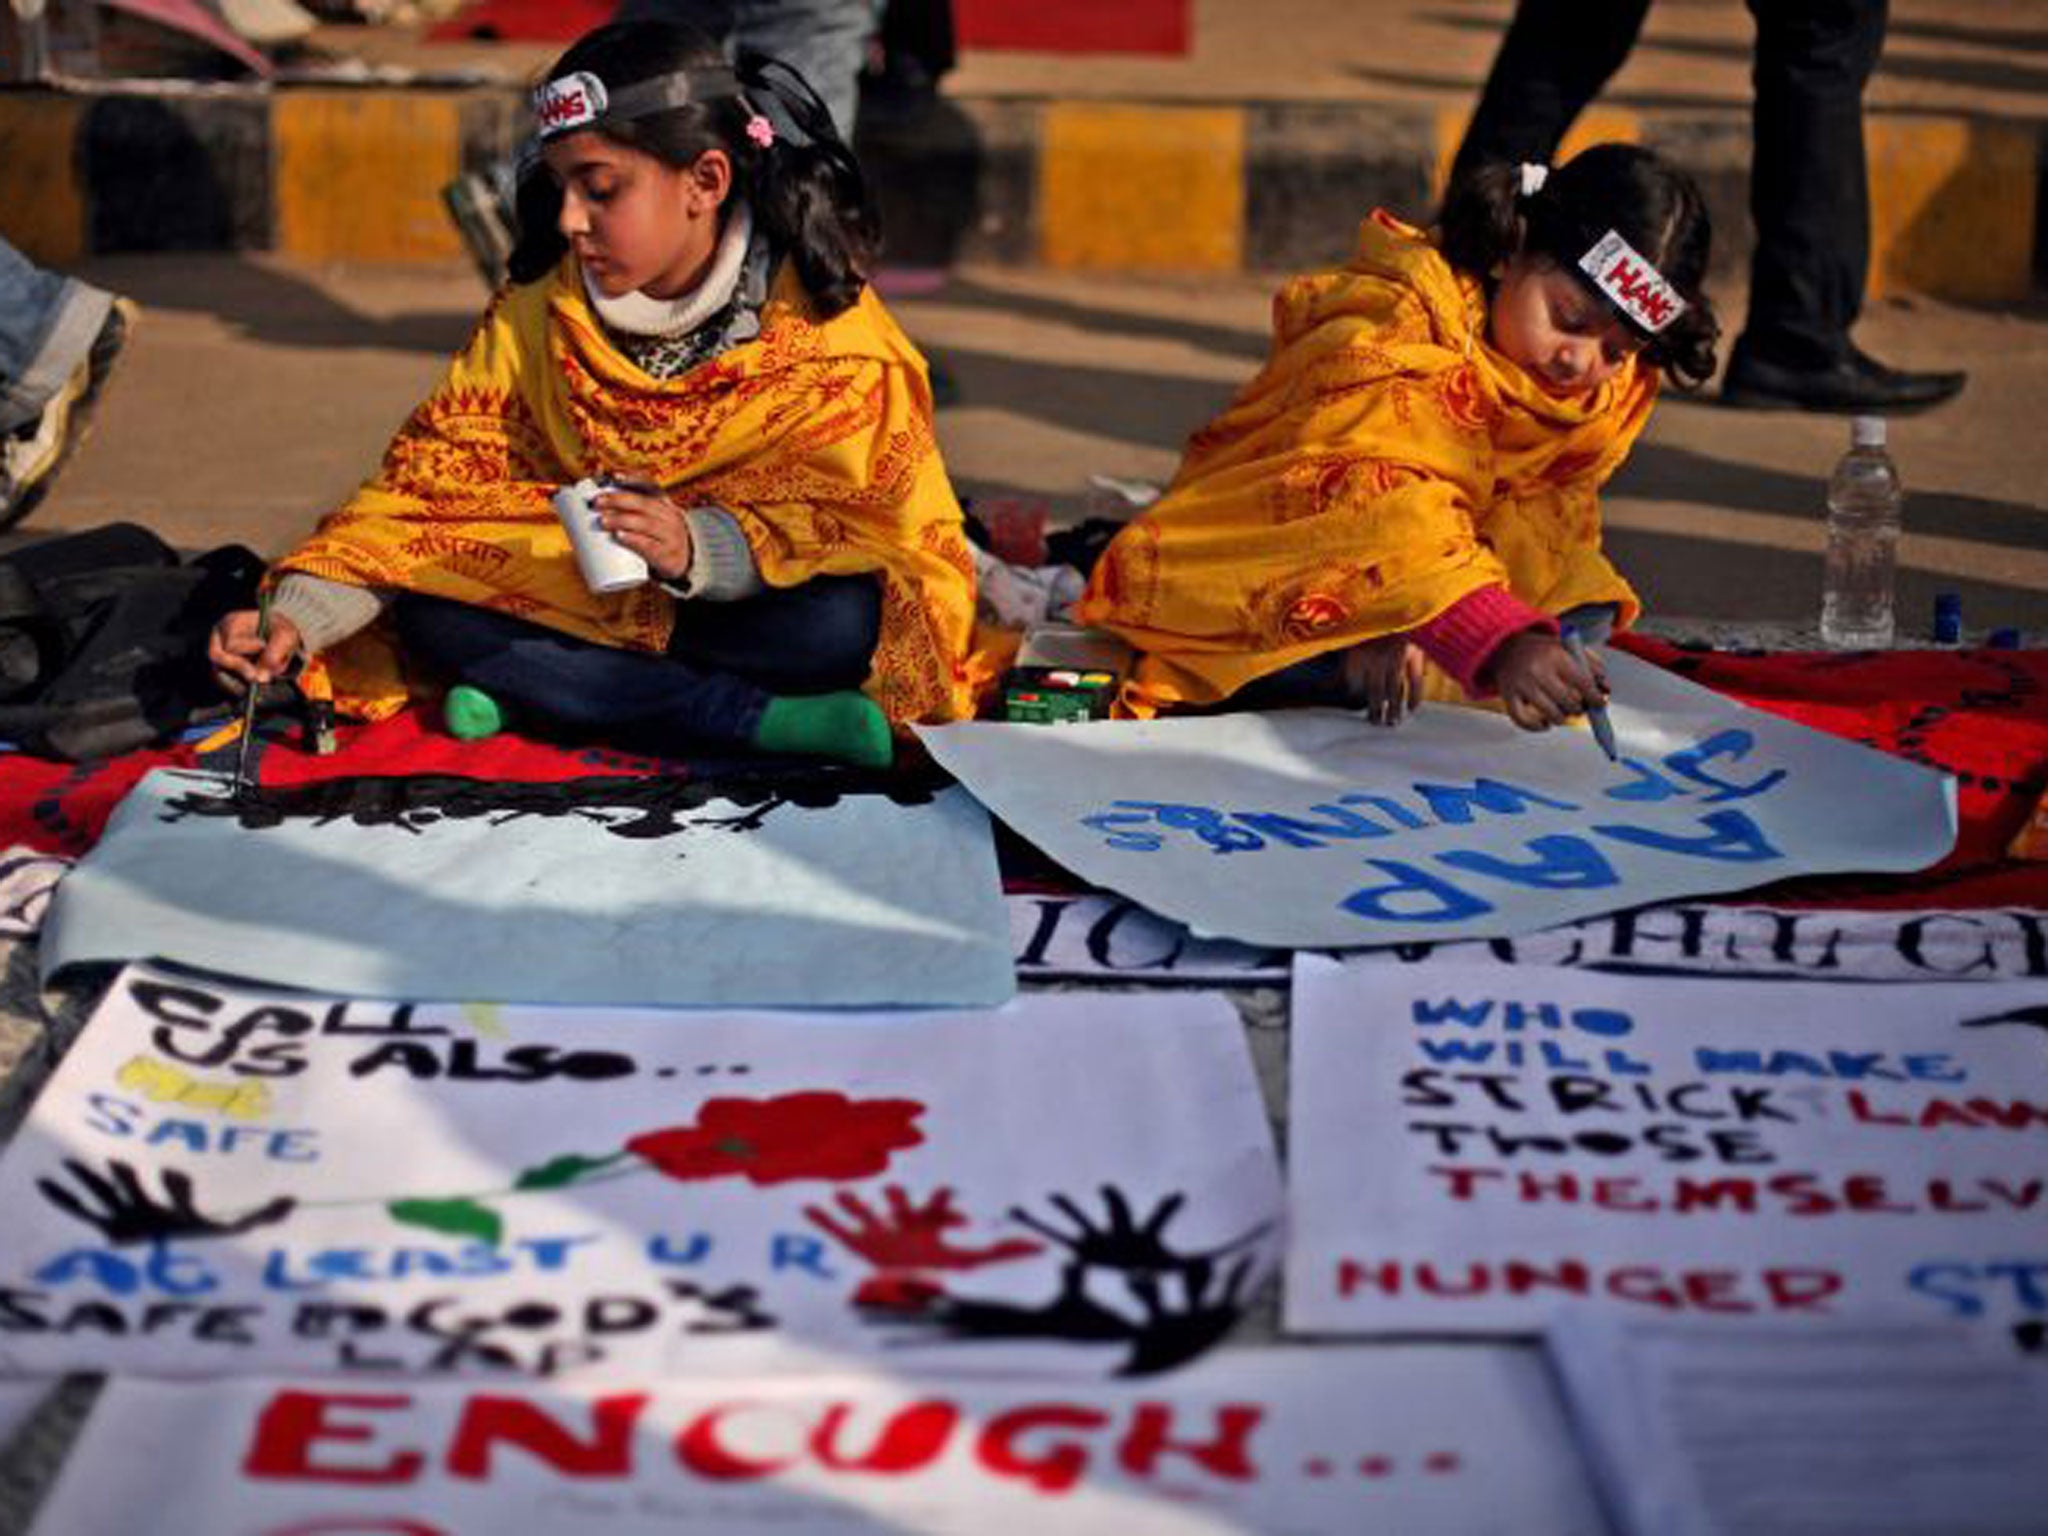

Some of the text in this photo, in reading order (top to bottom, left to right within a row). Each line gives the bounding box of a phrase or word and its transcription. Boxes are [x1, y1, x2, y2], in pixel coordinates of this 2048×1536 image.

[1338, 808, 1785, 923] AAP
[1412, 998, 1634, 1037] WHO
[1418, 1040, 1967, 1082] WILL MAKE
[1401, 1068, 1798, 1124] STRICK
[84, 1093, 320, 1163] SAFE
[262, 1234, 594, 1290] LEAST
[646, 1235, 712, 1265] U
[771, 1235, 838, 1278] R
[1337, 1259, 1844, 1313] HUNGER
[0, 1290, 264, 1344] SAFE
